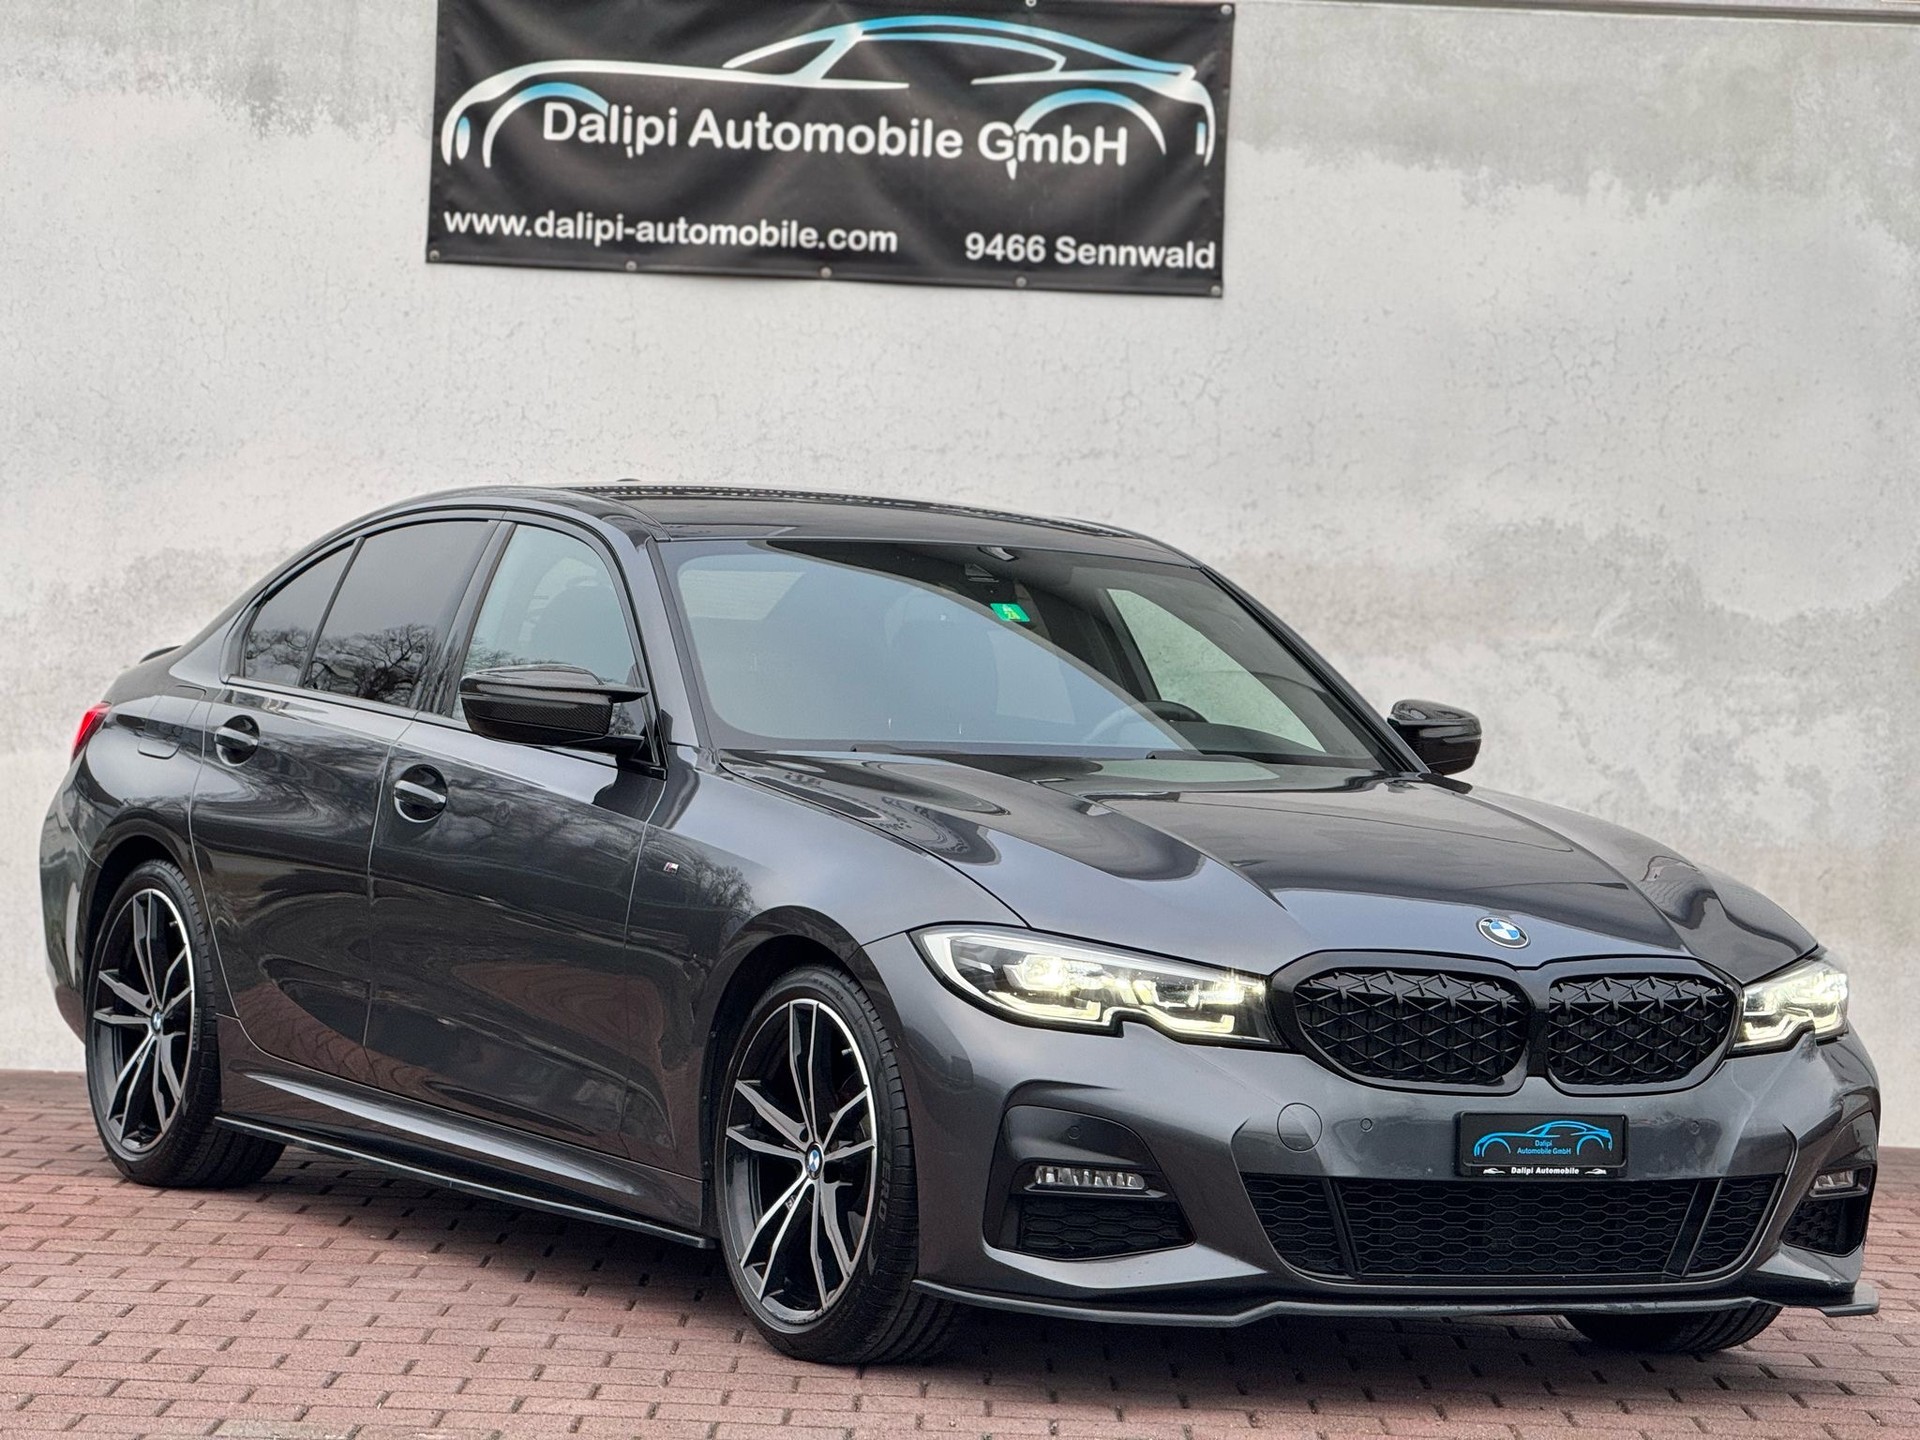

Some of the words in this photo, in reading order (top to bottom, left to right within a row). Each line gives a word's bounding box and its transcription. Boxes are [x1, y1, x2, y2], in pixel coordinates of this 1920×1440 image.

[543, 102, 678, 156] Dalipi
[688, 107, 964, 160] Automobile
[978, 121, 1128, 166] GmbH
[443, 209, 898, 254] www.dalipi-automobile.com
[965, 232, 1046, 263] 9466
[1054, 236, 1216, 269] Sennwald
[1517, 1147, 1551, 1155] Automobile
[1552, 1147, 1571, 1155] GmbH
[1511, 1167, 1533, 1175] Dalipi
[1535, 1167, 1579, 1175] Automobile
